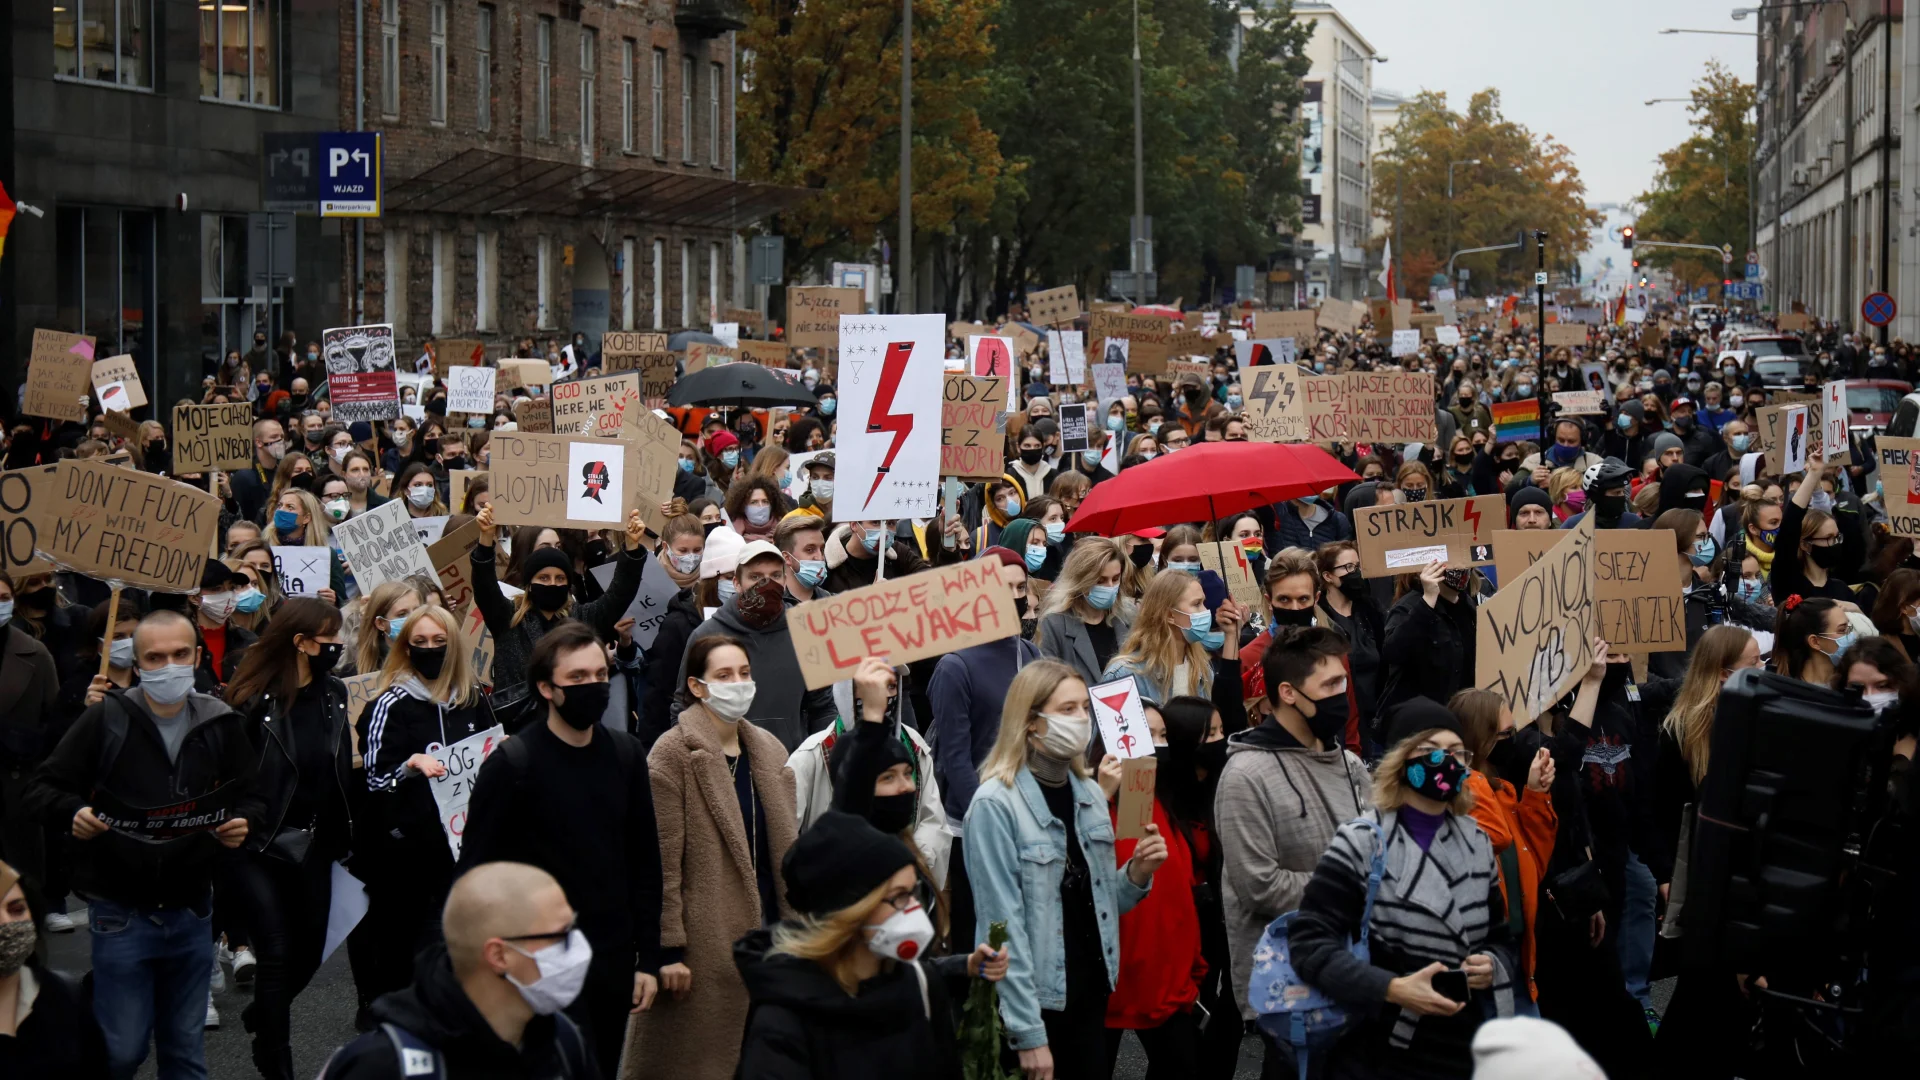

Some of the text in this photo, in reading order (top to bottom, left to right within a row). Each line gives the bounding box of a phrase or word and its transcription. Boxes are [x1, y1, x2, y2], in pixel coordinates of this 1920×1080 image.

[329, 147, 349, 178] P
[333, 184, 364, 194] WJAZD
[333, 203, 371, 211] Interparking
[603, 333, 666, 352] KOBIETA
[608, 353, 676, 370] MOJE CIAŁO
[331, 375, 358, 384] ABORCJA
[553, 380, 627, 400] GOD IS NOT
[1347, 375, 1390, 393] WASZE
[31, 391, 45, 400] TO
[449, 399, 490, 410] ABORTUS
[589, 399, 606, 412] WE
[177, 404, 251, 437] MOJE CIAŁO
[522, 411, 550, 421] MNIE
[581, 413, 597, 437] JUST
[522, 421, 552, 433] NIGDY
[556, 421, 581, 435] HAVE
[1350, 418, 1435, 440] NA TORTURY
[494, 436, 562, 467] TO JEST
[1882, 448, 1912, 465] PIEK
[65, 466, 205, 533] DON'T FUCK
[494, 472, 566, 515] WOJNA
[106, 513, 146, 534] WITH
[347, 514, 385, 546] NO
[1367, 503, 1455, 537] STRAJK
[52, 517, 202, 588] MY FREEDOM
[347, 521, 422, 573] WOMEN
[378, 555, 410, 582] NO
[806, 562, 1003, 636] URODZĘ WAM
[825, 593, 1000, 669] LEWAKA
[436, 747, 475, 783] BÓG
[452, 782, 462, 797] Z
[97, 812, 140, 829] PRAWO
[146, 820, 164, 829] DO
[171, 808, 226, 828] ABORCJI
